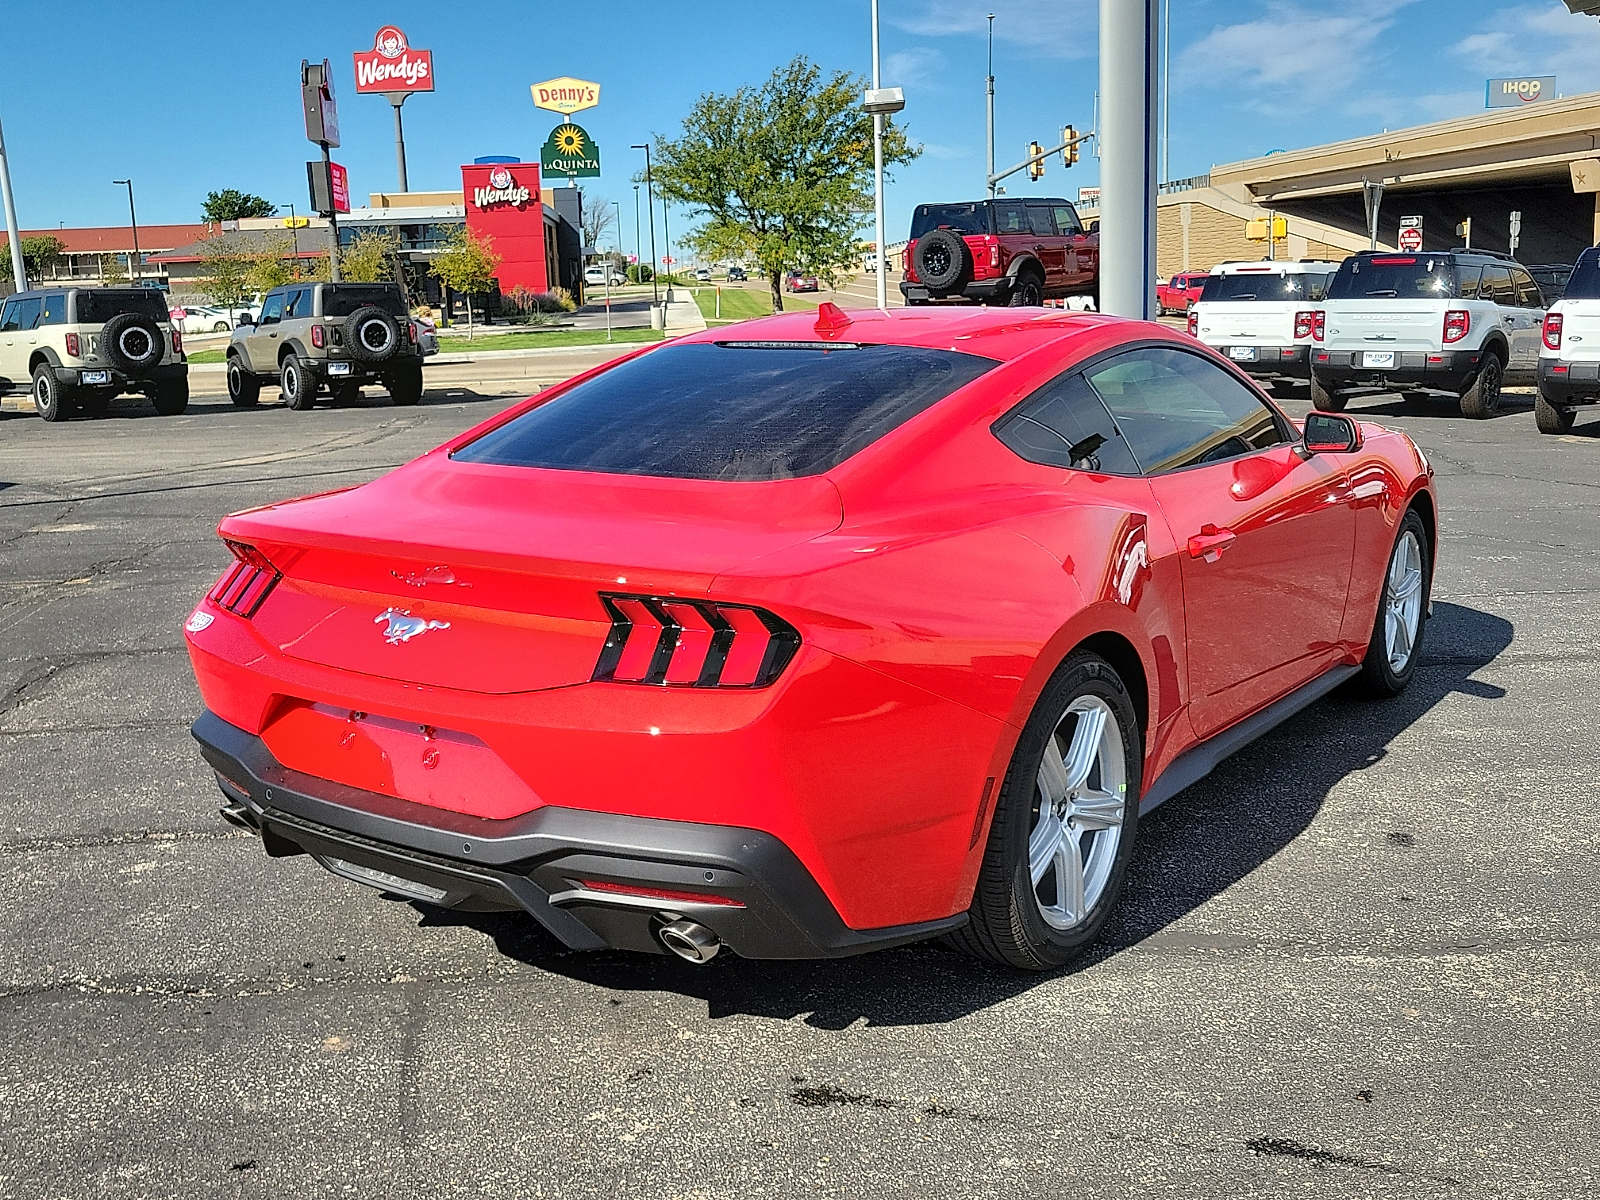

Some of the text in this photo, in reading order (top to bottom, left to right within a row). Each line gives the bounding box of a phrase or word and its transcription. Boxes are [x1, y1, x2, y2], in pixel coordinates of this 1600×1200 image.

[357, 54, 428, 87] Wendy's
[538, 86, 595, 103] Denny's
[552, 159, 600, 171] QUINTA
[474, 182, 530, 208] Wendy's
